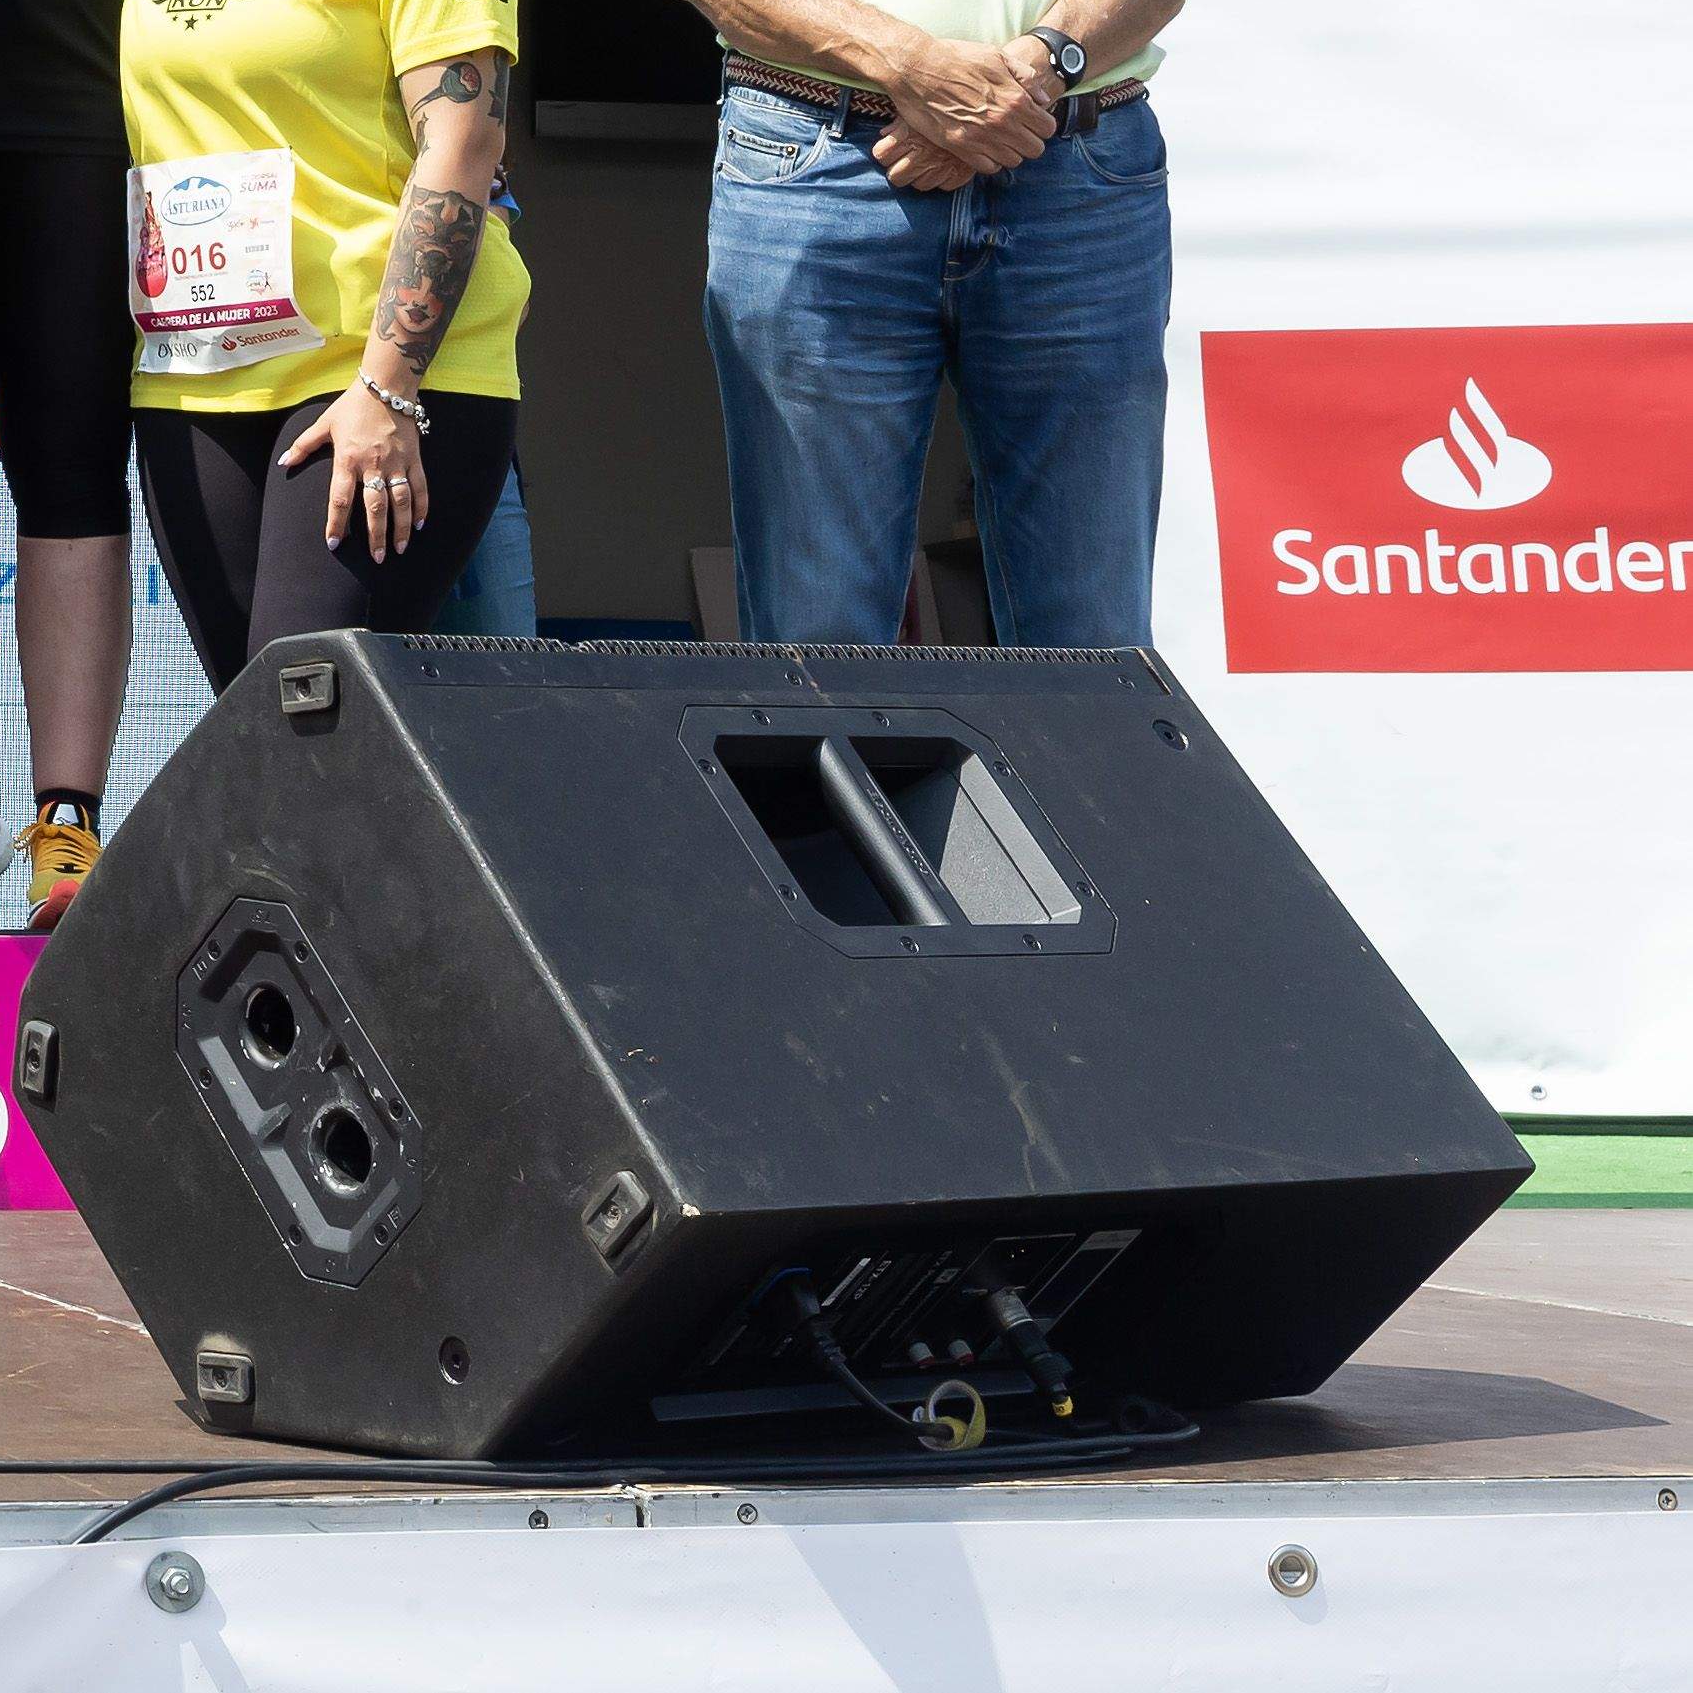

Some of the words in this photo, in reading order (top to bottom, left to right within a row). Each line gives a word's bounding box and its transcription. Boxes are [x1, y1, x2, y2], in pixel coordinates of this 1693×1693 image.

[240, 180, 277, 193] SUMA
[171, 242, 227, 275] 016
[191, 284, 216, 302] 552
[189, 313, 203, 325] DE
[203, 311, 216, 323] LA
[216, 308, 251, 322] MUJER
[254, 305, 279, 318] 2023
[237, 326, 300, 348] Santander
[1272, 527, 1693, 596] Santander
